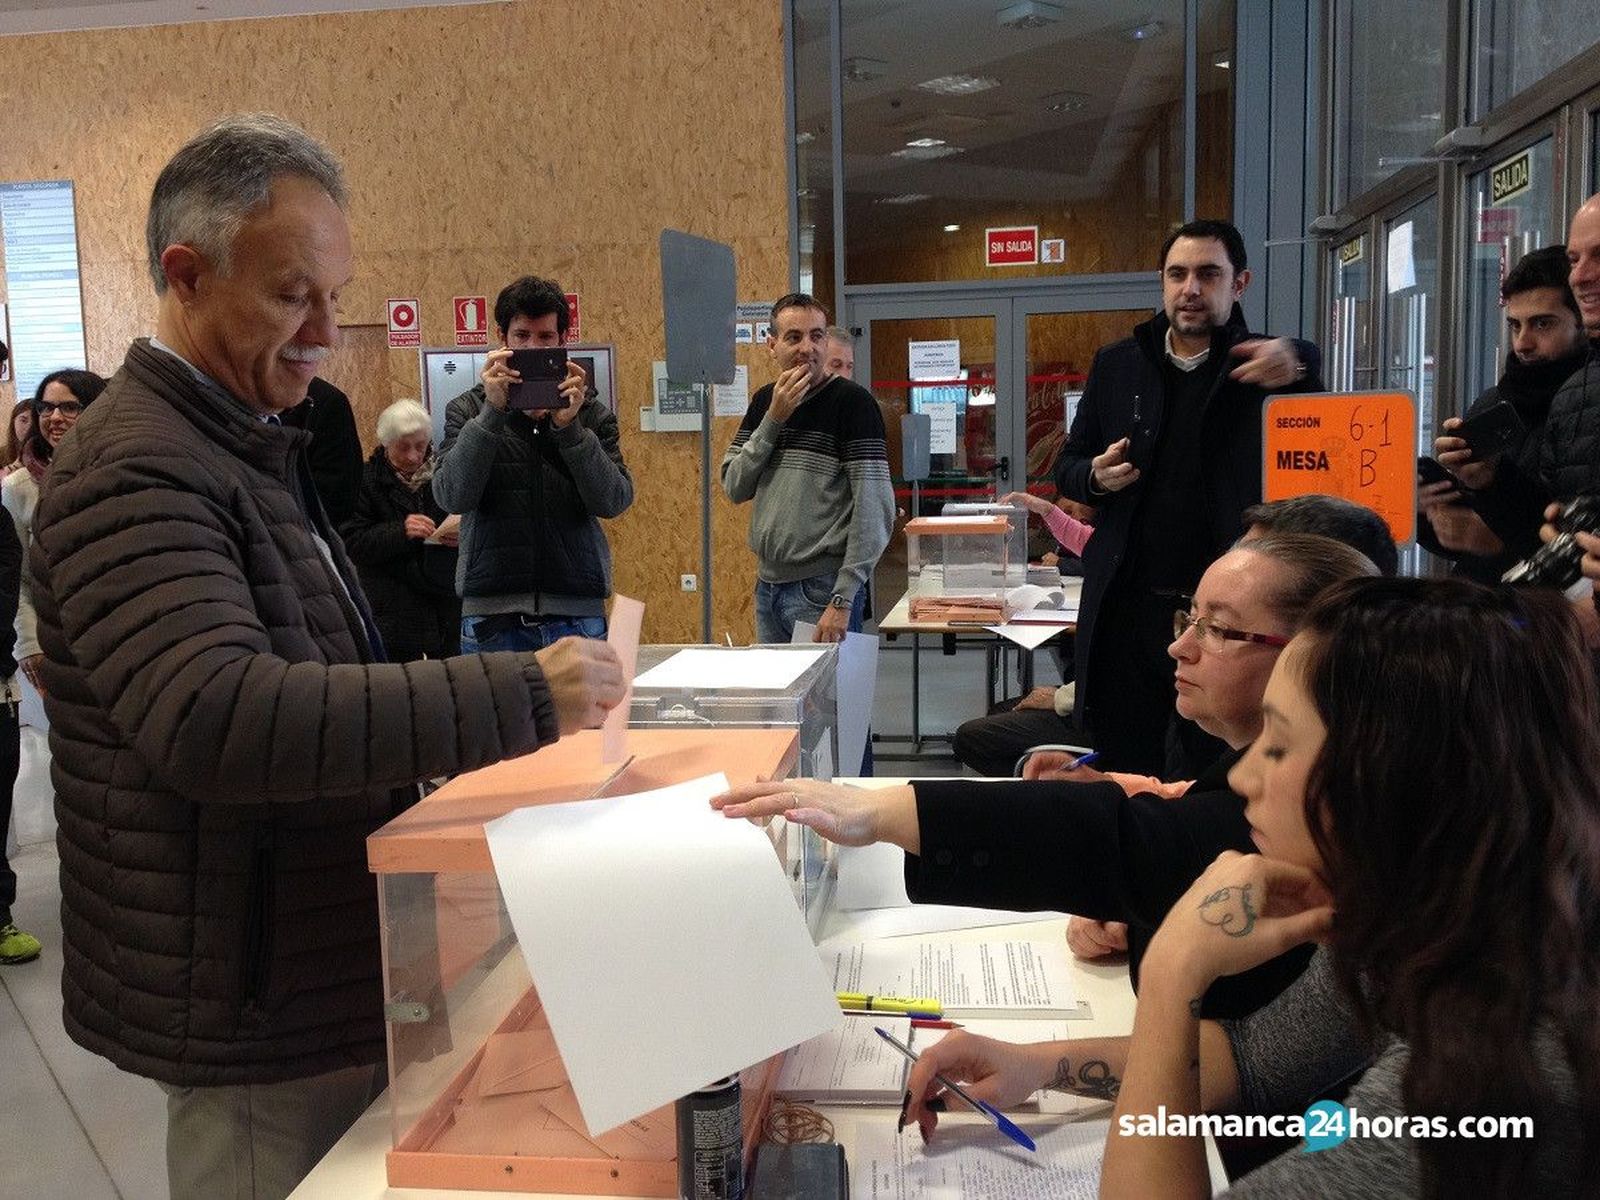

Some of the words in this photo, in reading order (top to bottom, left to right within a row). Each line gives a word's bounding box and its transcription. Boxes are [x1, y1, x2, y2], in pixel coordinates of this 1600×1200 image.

[1494, 161, 1528, 195] SALIDA
[991, 241, 1005, 253] SIN
[1006, 240, 1033, 253] SALIDA
[456, 334, 488, 344] EXTINTOR
[1276, 415, 1321, 428] SECCIÓN
[1349, 404, 1392, 447] 6-1
[1276, 450, 1330, 471] MESA
[1359, 448, 1377, 488] B
